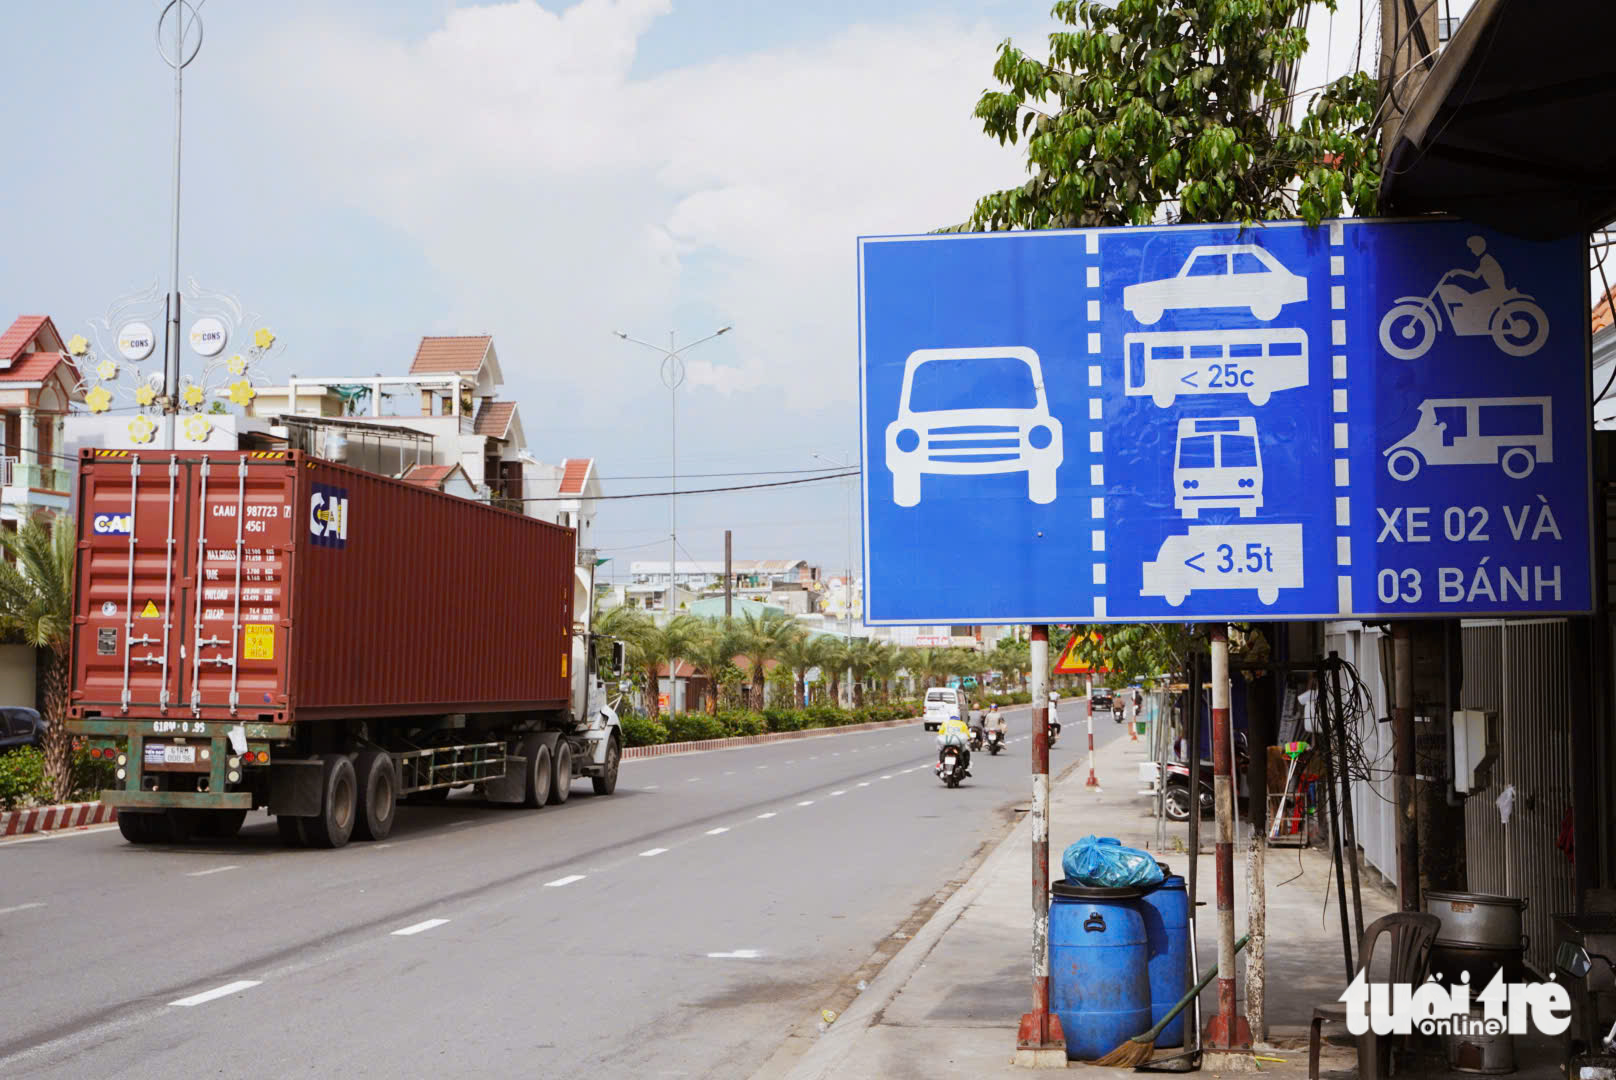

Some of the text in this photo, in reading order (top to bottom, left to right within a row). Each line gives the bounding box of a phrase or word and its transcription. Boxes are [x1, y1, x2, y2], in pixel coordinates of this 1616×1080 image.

[1208, 363, 1255, 388] 25c
[213, 505, 237, 517] CAAU
[246, 505, 278, 518] 987723
[245, 520, 266, 533] 45G1
[309, 492, 349, 540] CAI
[1376, 494, 1563, 543] XE 02 VÀ
[1216, 543, 1274, 573] 3.5t
[1377, 556, 1562, 604] 03 BÁNH
